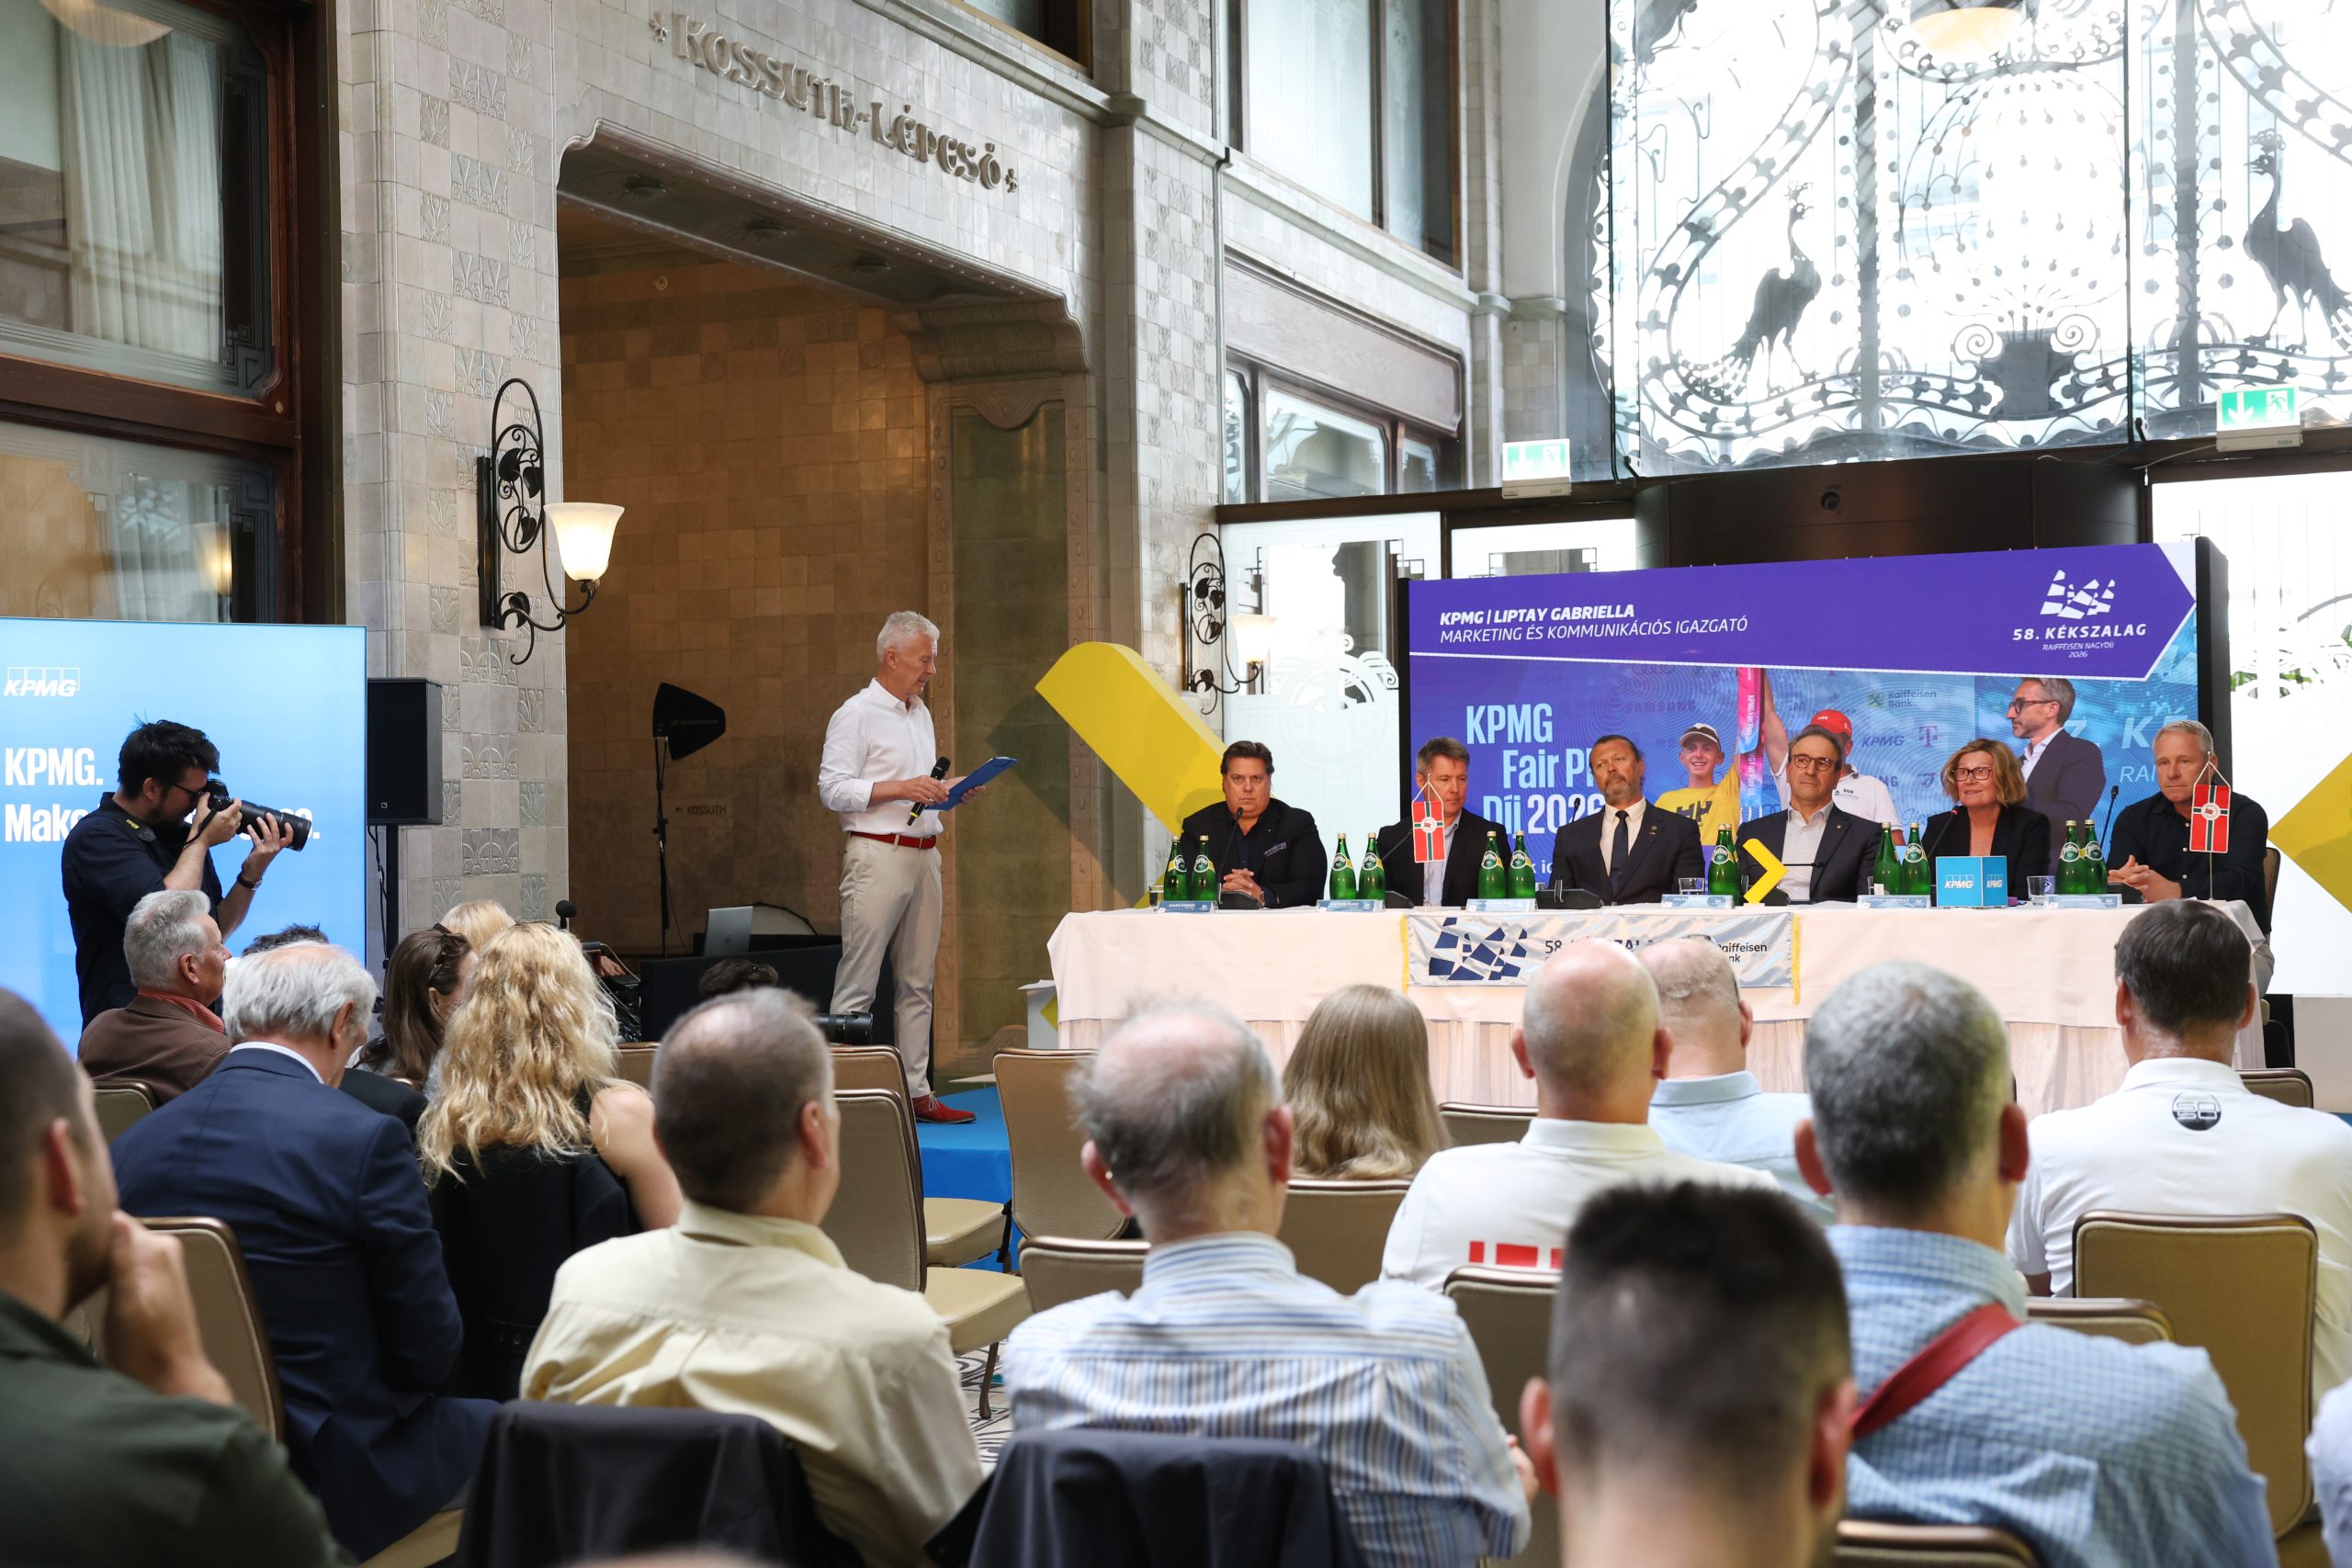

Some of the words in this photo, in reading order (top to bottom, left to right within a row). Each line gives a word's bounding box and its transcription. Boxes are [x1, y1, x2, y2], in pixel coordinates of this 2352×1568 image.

[1440, 612, 1484, 626] KPMG
[1494, 608, 1548, 624] LIPTAY
[1551, 604, 1634, 621] GABRIELLA
[1440, 627, 1522, 644] MARKETING
[1526, 624, 1544, 640] ÉS
[1547, 618, 1672, 639] KOMMUNIKÁCIÓS
[1675, 615, 1748, 634] IGAZGATÓ
[2012, 628, 2040, 641] 58.
[2044, 624, 2147, 640] KÉKSZALAG
[2042, 642, 2084, 651] RAIFFEISEN
[2068, 650, 2088, 659] 2026
[4, 679, 77, 697] KPMG
[1888, 689, 1937, 698] Raiffeisen
[1888, 700, 1913, 708] Bank
[1466, 703, 1554, 745] KPMG
[1861, 735, 1905, 748] KPMG
[5, 747, 104, 786] KPMG.
[1502, 749, 1559, 789] Fair
[1566, 748, 1594, 787] Pl
[1944, 879, 1973, 889] KPMG
[1986, 879, 2003, 888] KPMG
